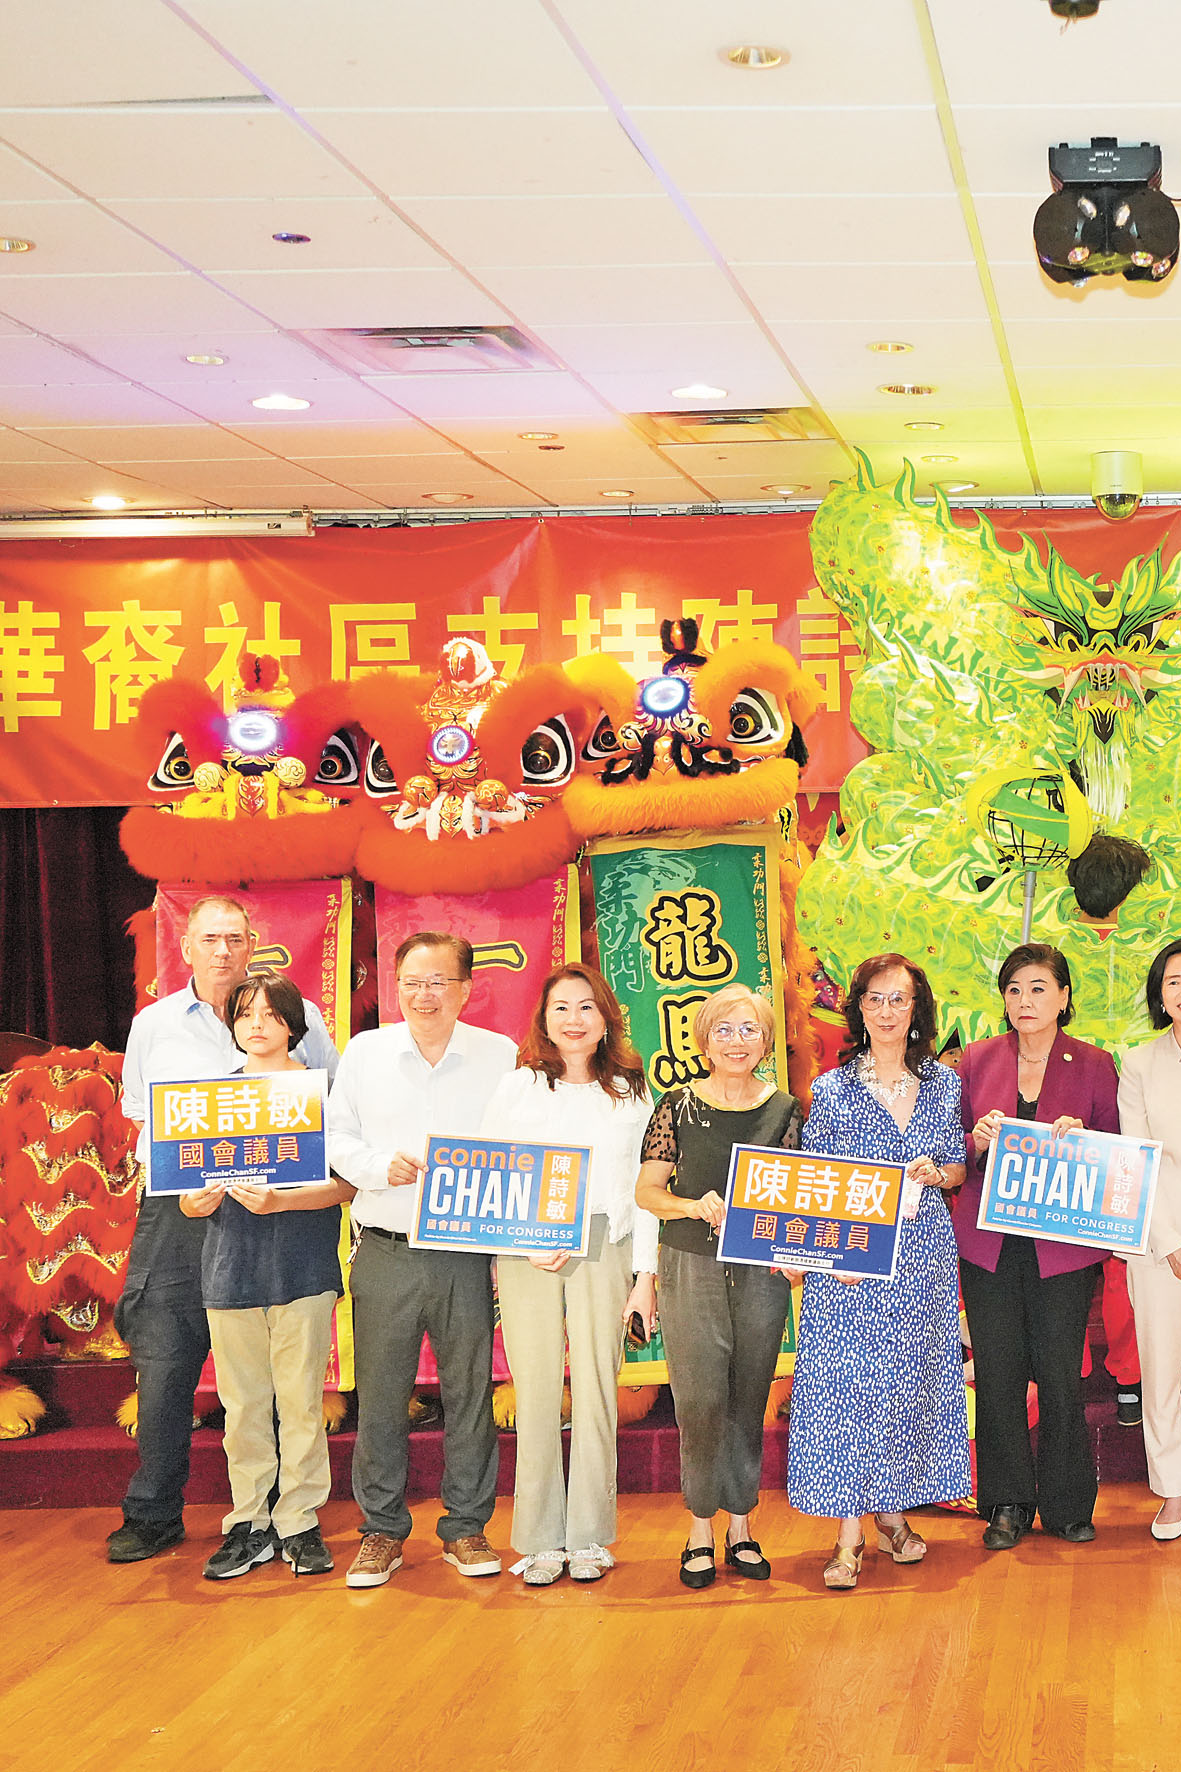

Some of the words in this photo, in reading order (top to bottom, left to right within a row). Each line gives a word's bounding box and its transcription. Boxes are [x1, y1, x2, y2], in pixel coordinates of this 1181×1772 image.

[164, 1084, 311, 1136] 陳詩敏
[179, 1136, 300, 1170] 國會議員
[434, 1146, 535, 1171] connie
[1004, 1134, 1100, 1164] connie
[201, 1168, 277, 1179] ConnieChanSF.com
[546, 1155, 572, 1220] 陳詩敏
[744, 1158, 890, 1218] 陳詩敏
[997, 1152, 1099, 1213] CHAN
[428, 1166, 533, 1221] CHAN
[480, 1224, 503, 1235] FOR
[507, 1226, 574, 1239] CONGRESS
[752, 1213, 869, 1252] 國會議員
[1045, 1212, 1068, 1224] FOR
[1072, 1216, 1135, 1234] CONGRESS
[770, 1245, 844, 1260] ConnieChanSF.com
